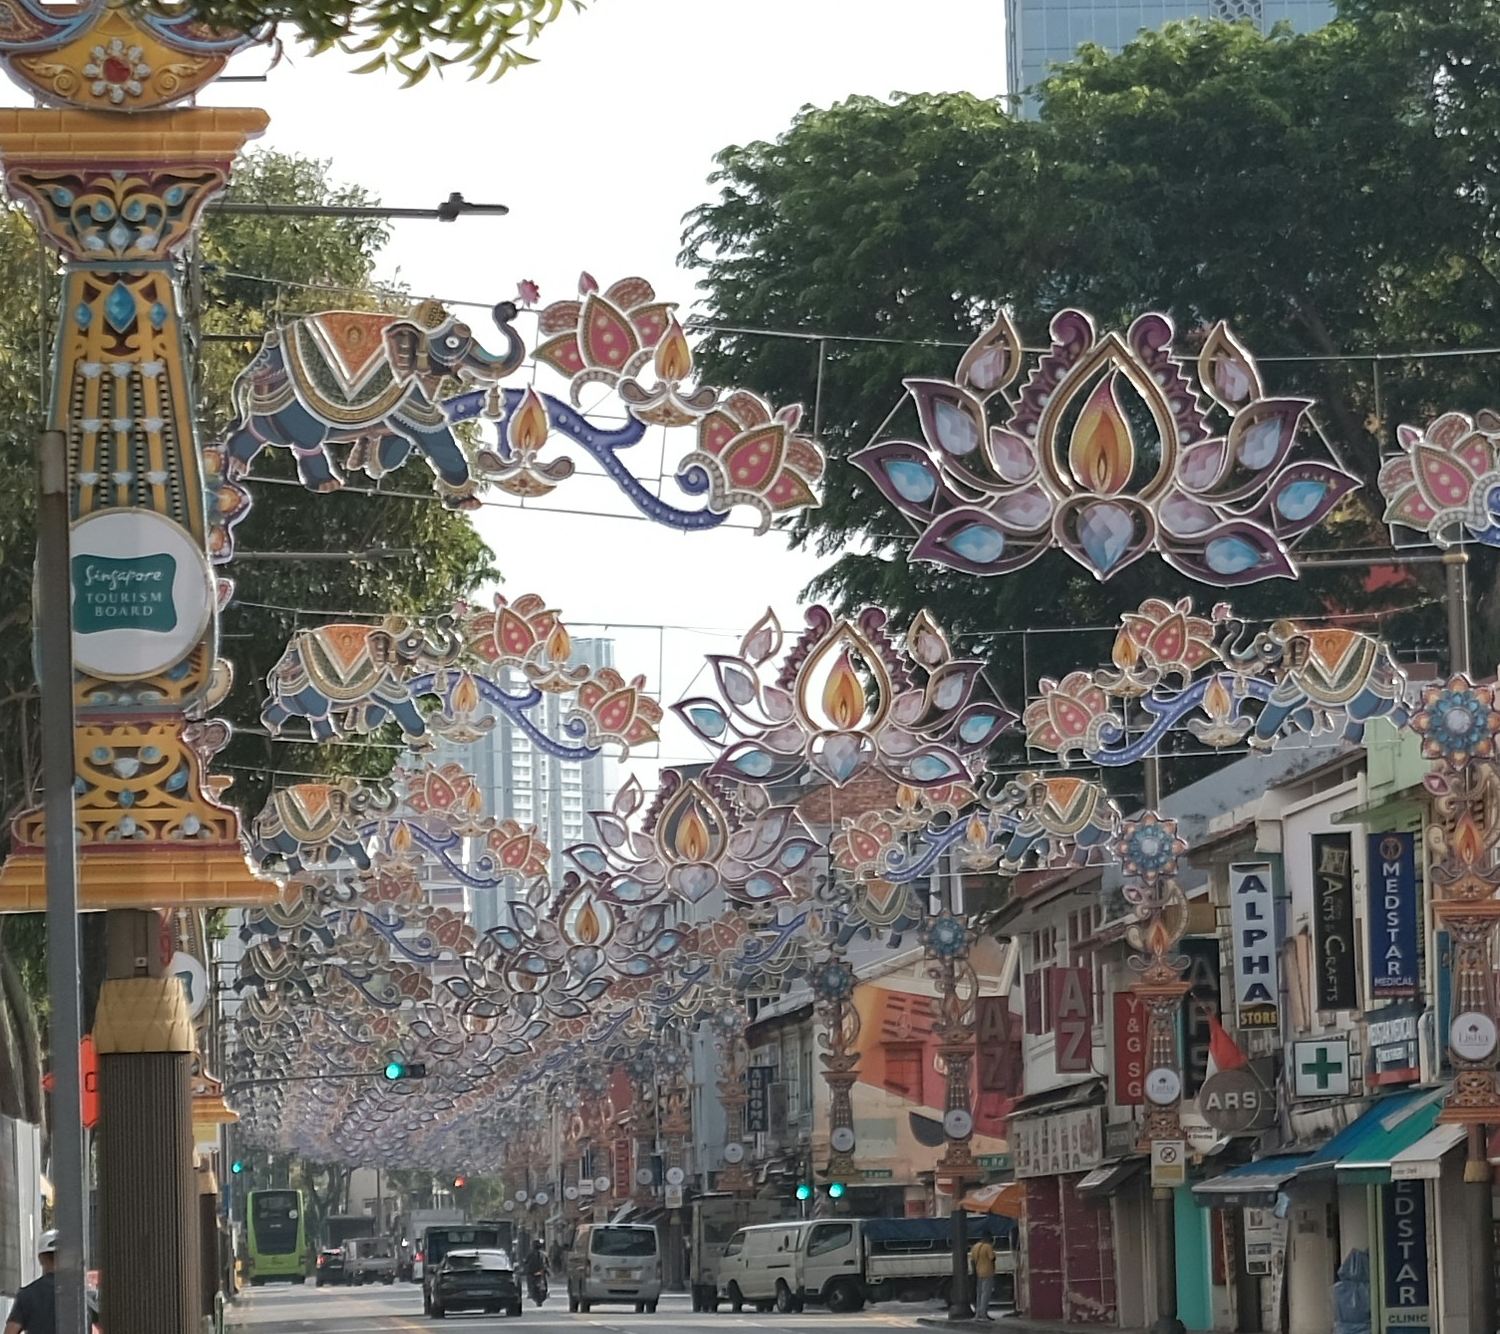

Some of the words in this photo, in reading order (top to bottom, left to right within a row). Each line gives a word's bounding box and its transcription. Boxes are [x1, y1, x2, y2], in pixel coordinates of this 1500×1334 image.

[85, 564, 162, 590] Singapore
[86, 592, 162, 603] TOURISM
[95, 605, 153, 617] BOARD
[1382, 862, 1402, 975] MEDSTAR
[1237, 874, 1273, 1003] ALPHA
[1374, 976, 1414, 987] MEDICAL
[1059, 969, 1088, 1068] AZ
[1240, 1011, 1277, 1024] STORE
[1205, 1091, 1257, 1110] ARS
[1388, 1314, 1428, 1324] CLINIC
